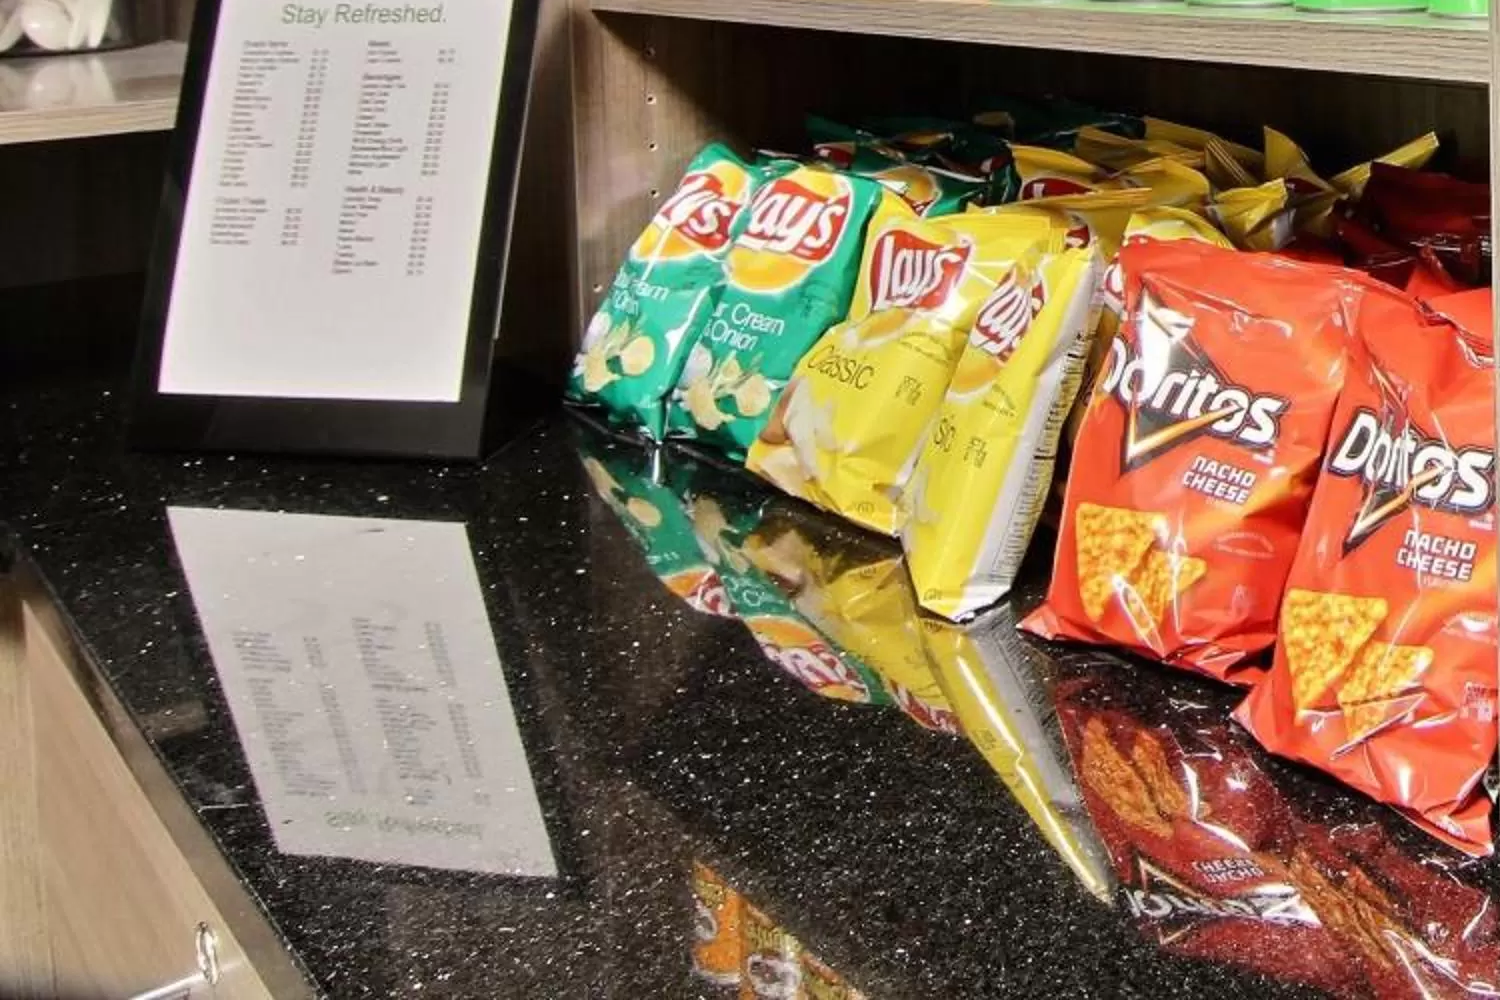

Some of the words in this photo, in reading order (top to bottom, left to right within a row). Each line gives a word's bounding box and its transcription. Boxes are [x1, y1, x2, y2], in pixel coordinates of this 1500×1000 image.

[281, 3, 326, 28] Stay
[335, 3, 447, 23] Refreshed.
[873, 235, 962, 310] Lay's
[711, 320, 758, 350] Onion
[731, 303, 784, 336] Cream
[808, 344, 875, 390] Classic
[1183, 471, 1251, 504] CHEESE
[1192, 455, 1256, 488] NACHO
[1405, 529, 1477, 561] NACHO
[1396, 548, 1473, 580] CHEESE
